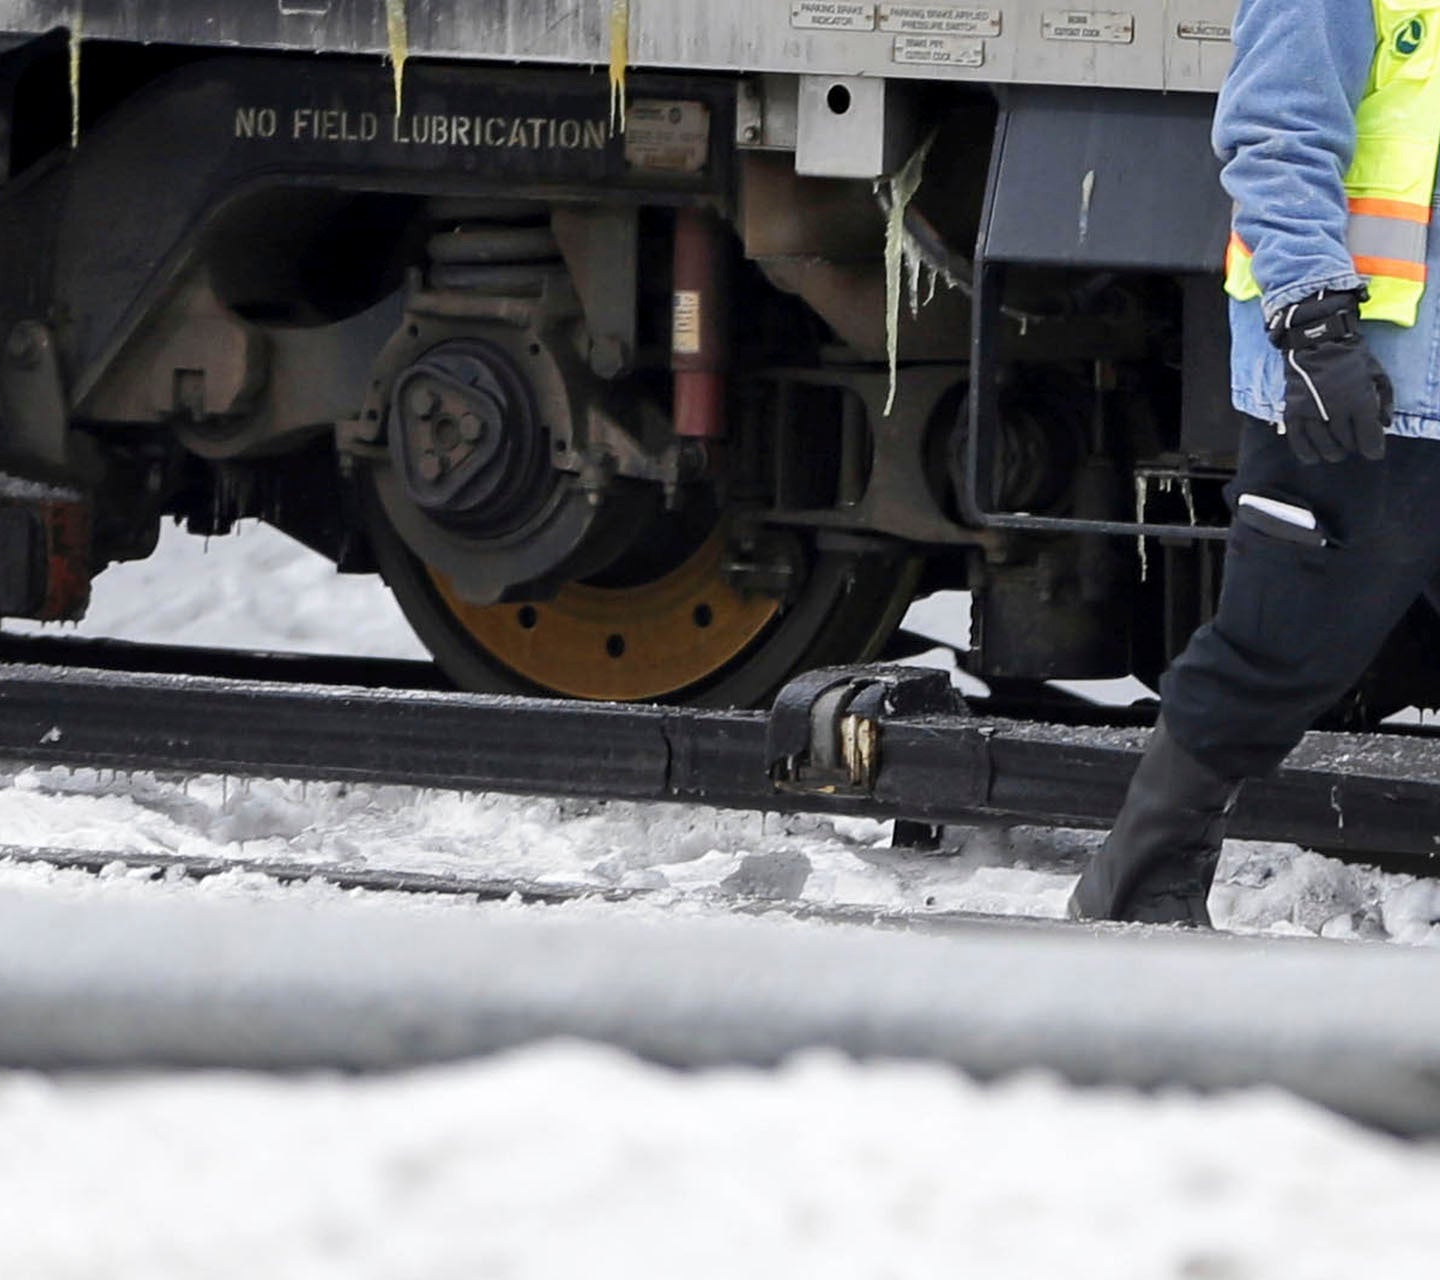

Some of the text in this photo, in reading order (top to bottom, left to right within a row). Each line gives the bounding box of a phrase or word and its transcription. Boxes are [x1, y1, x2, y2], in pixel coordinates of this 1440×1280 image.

[234, 107, 277, 139] NO
[293, 108, 378, 141] FIELD
[392, 114, 606, 150] LUBRICATION
